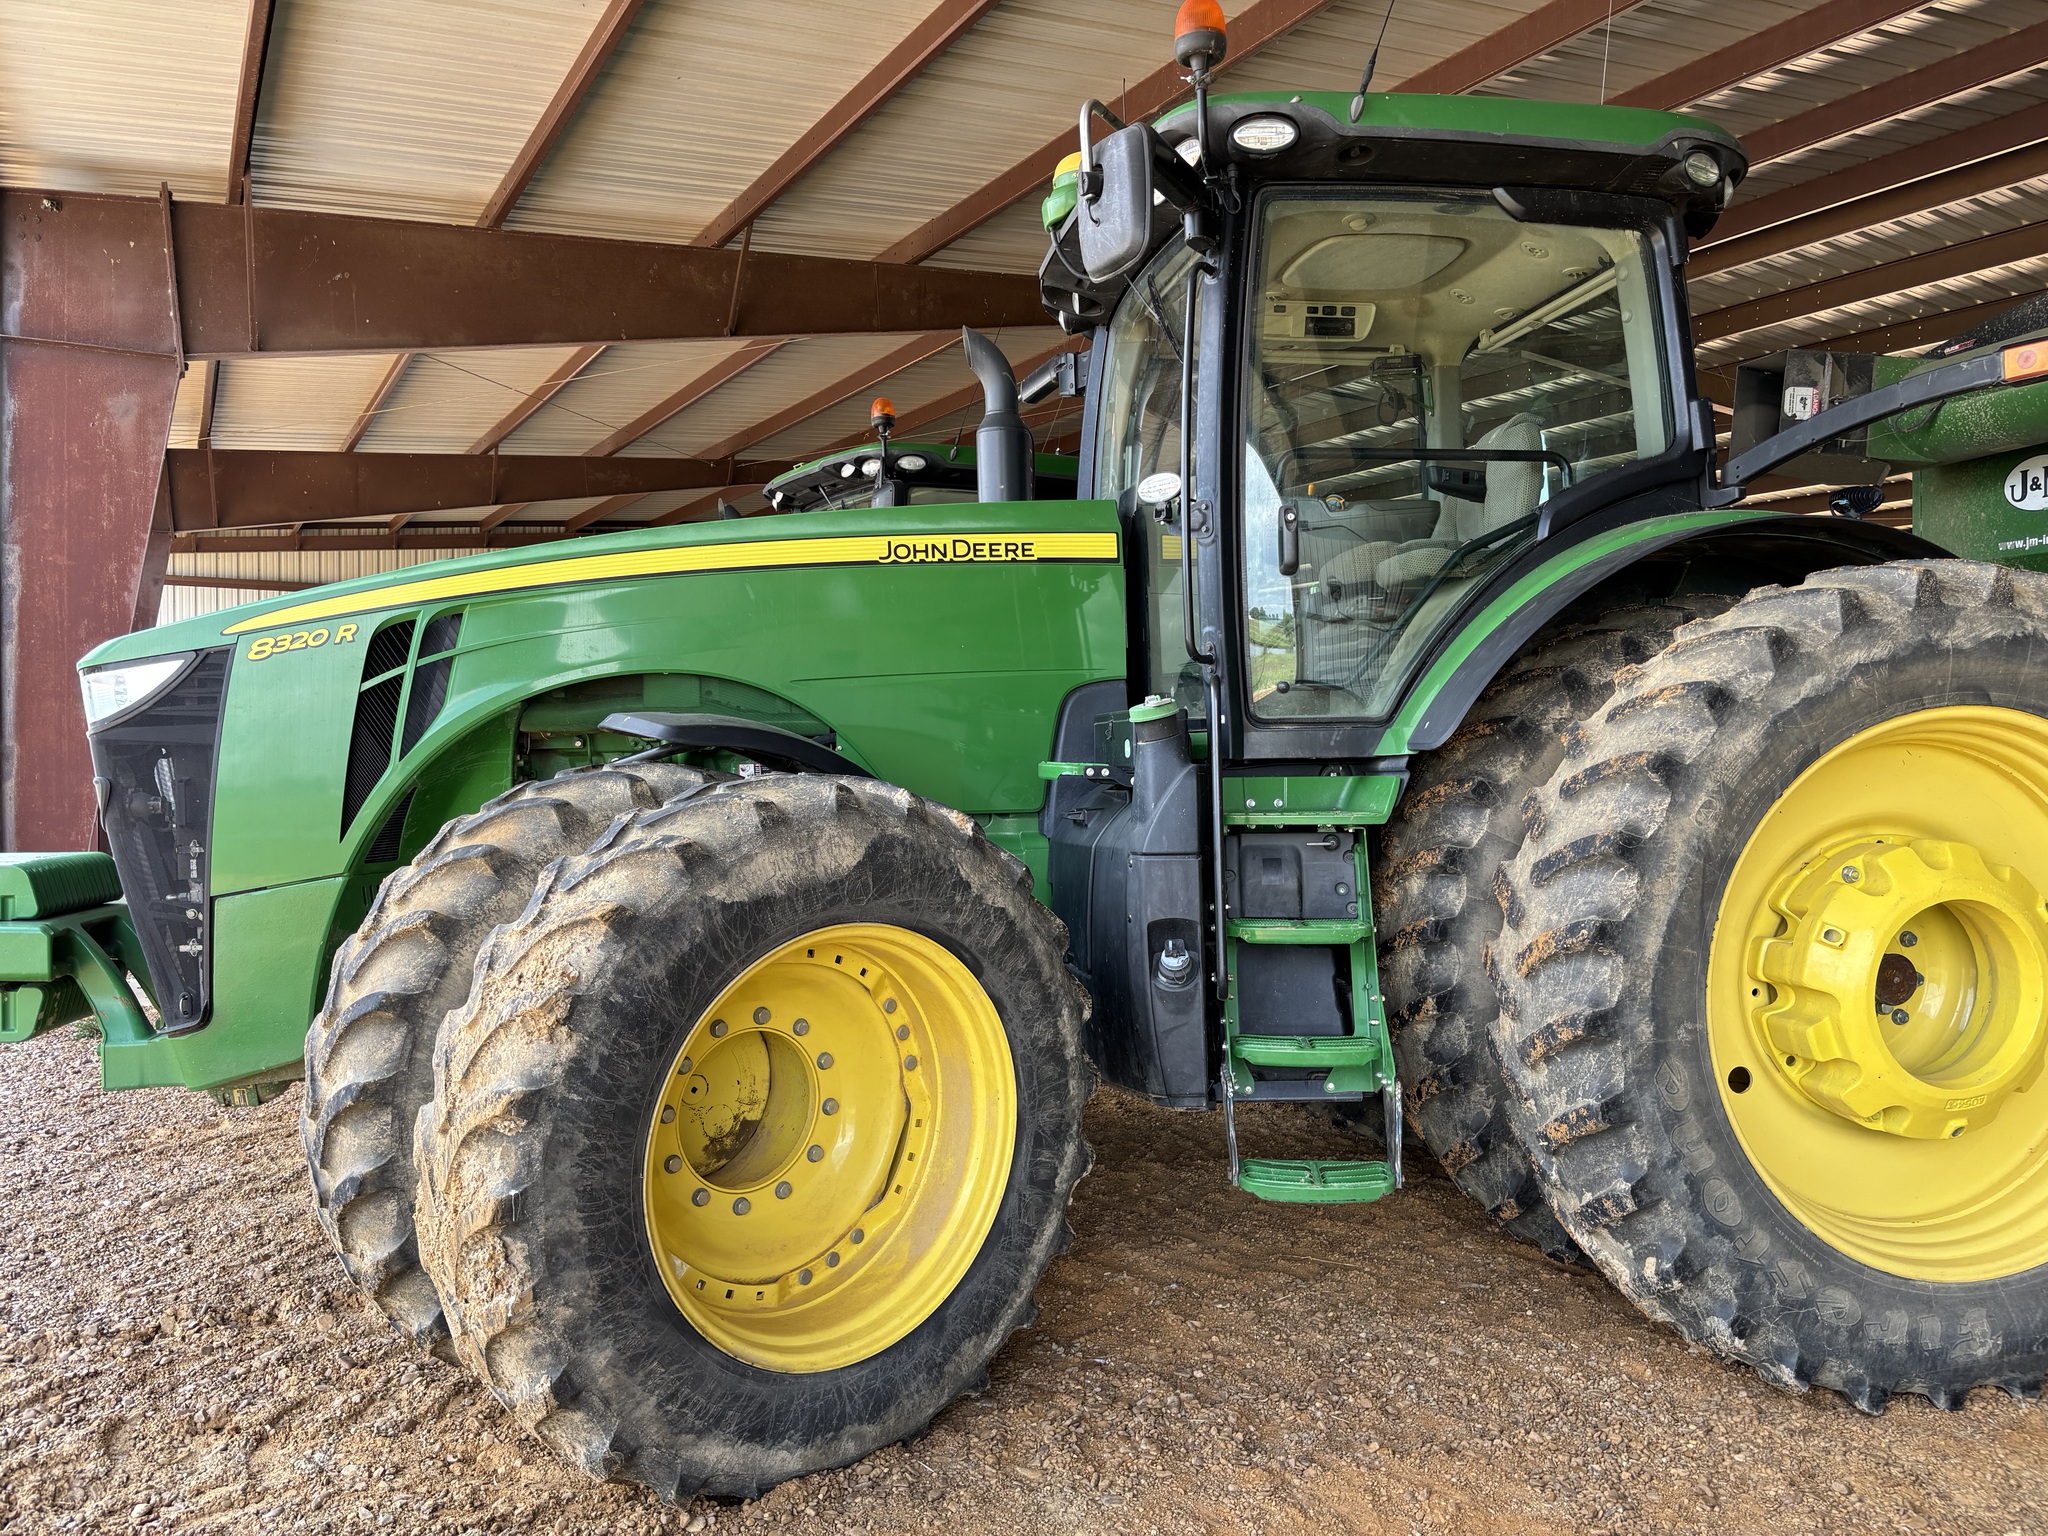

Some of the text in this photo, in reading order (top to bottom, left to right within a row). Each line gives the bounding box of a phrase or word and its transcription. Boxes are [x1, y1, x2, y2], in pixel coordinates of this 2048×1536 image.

[2009, 466, 2048, 503] J&
[247, 623, 360, 661] 8320 R
[1654, 1058, 1993, 1361] Firestone
